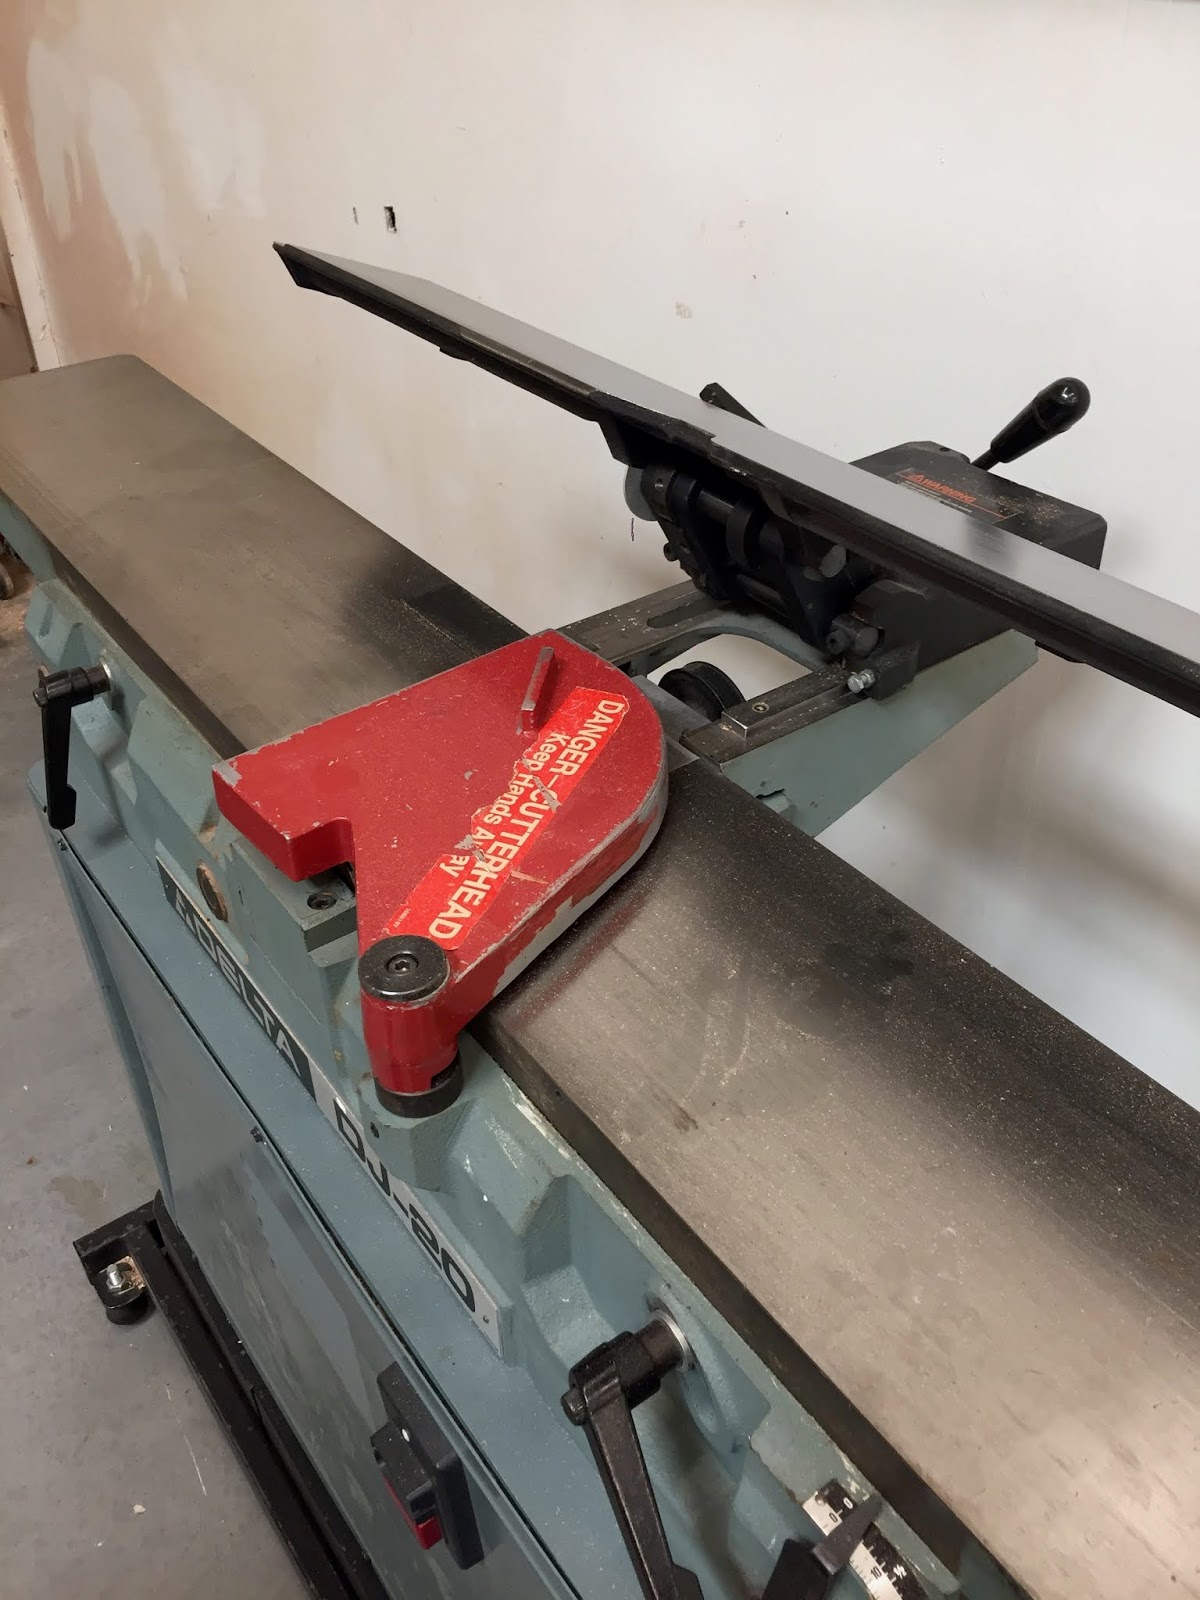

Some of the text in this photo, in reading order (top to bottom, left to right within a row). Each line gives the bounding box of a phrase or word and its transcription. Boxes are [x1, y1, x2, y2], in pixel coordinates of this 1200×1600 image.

[922, 479, 977, 503] WARNING
[524, 732, 572, 771] Keep
[482, 773, 535, 825] Hands
[193, 911, 302, 1077] DELTA
[333, 1097, 476, 1313] DJ-20
[829, 1512, 838, 1523] 0
[843, 1497, 854, 1509] 0
[870, 1566, 882, 1579] 10
